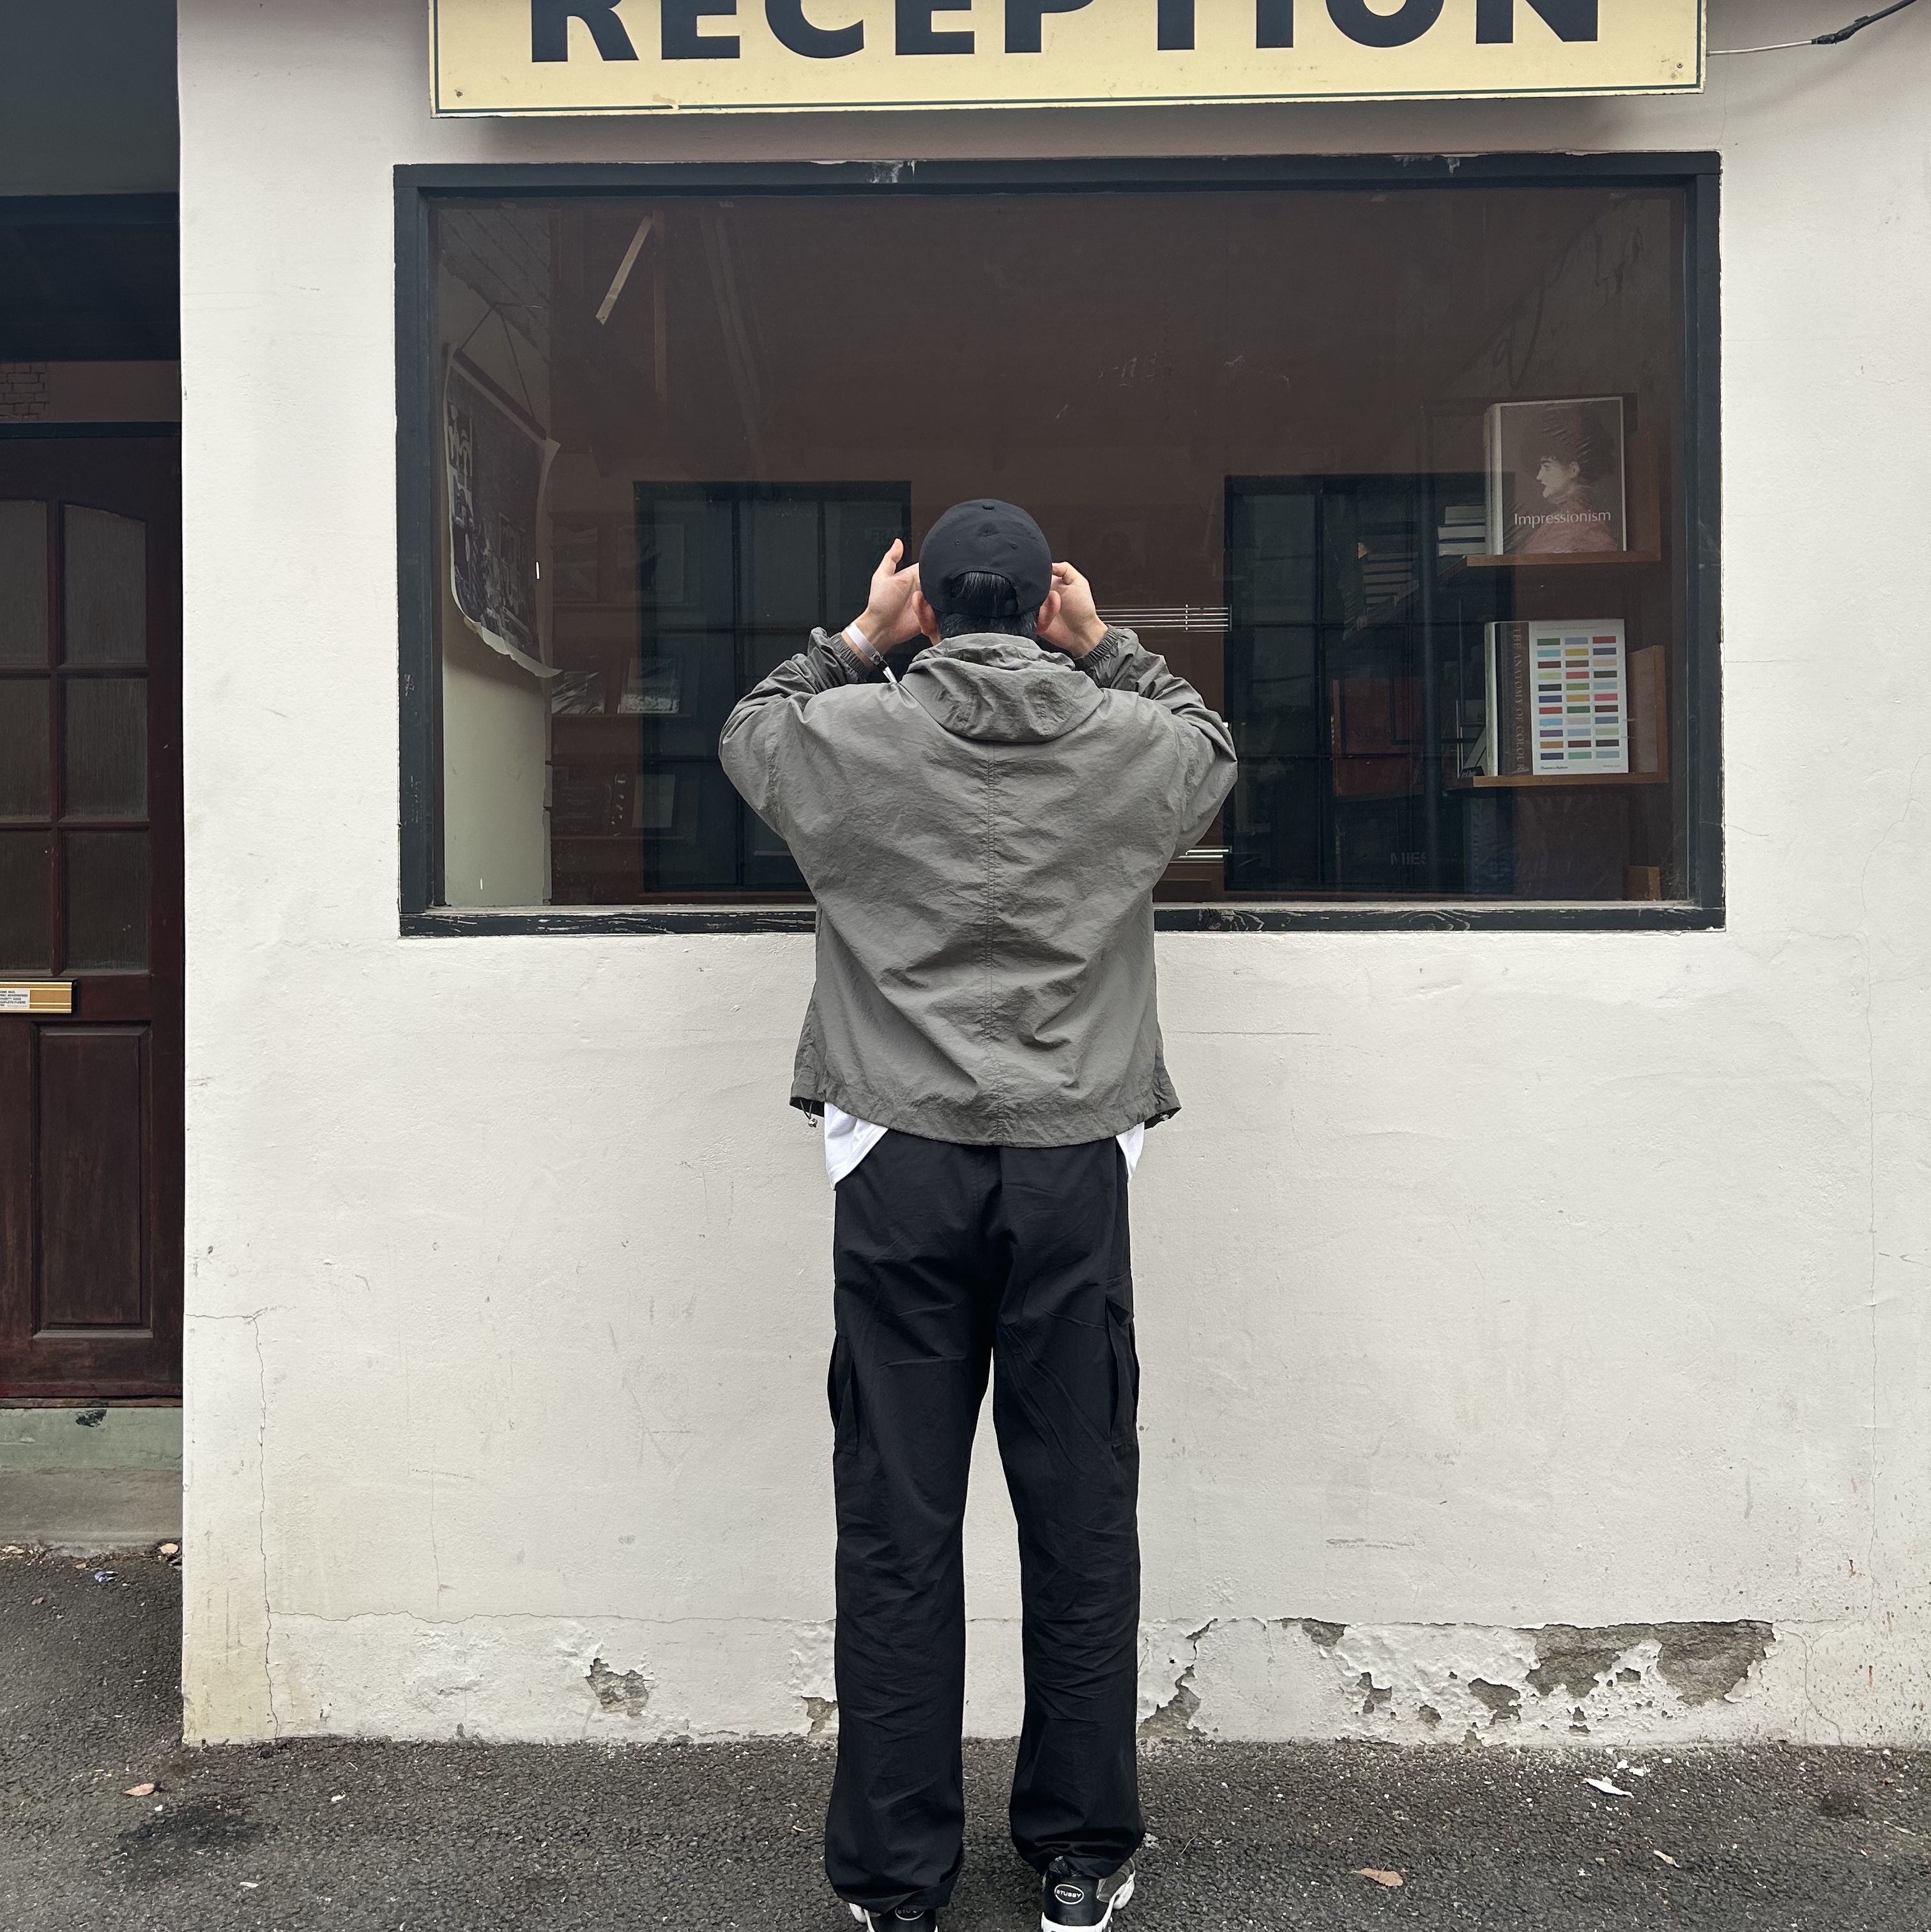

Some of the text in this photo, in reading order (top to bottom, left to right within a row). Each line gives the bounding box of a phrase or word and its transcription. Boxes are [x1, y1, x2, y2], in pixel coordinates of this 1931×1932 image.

[1515, 510, 1611, 529] Impressionism
[1513, 628, 1525, 771] THE ANATOMY OF COLOUR
